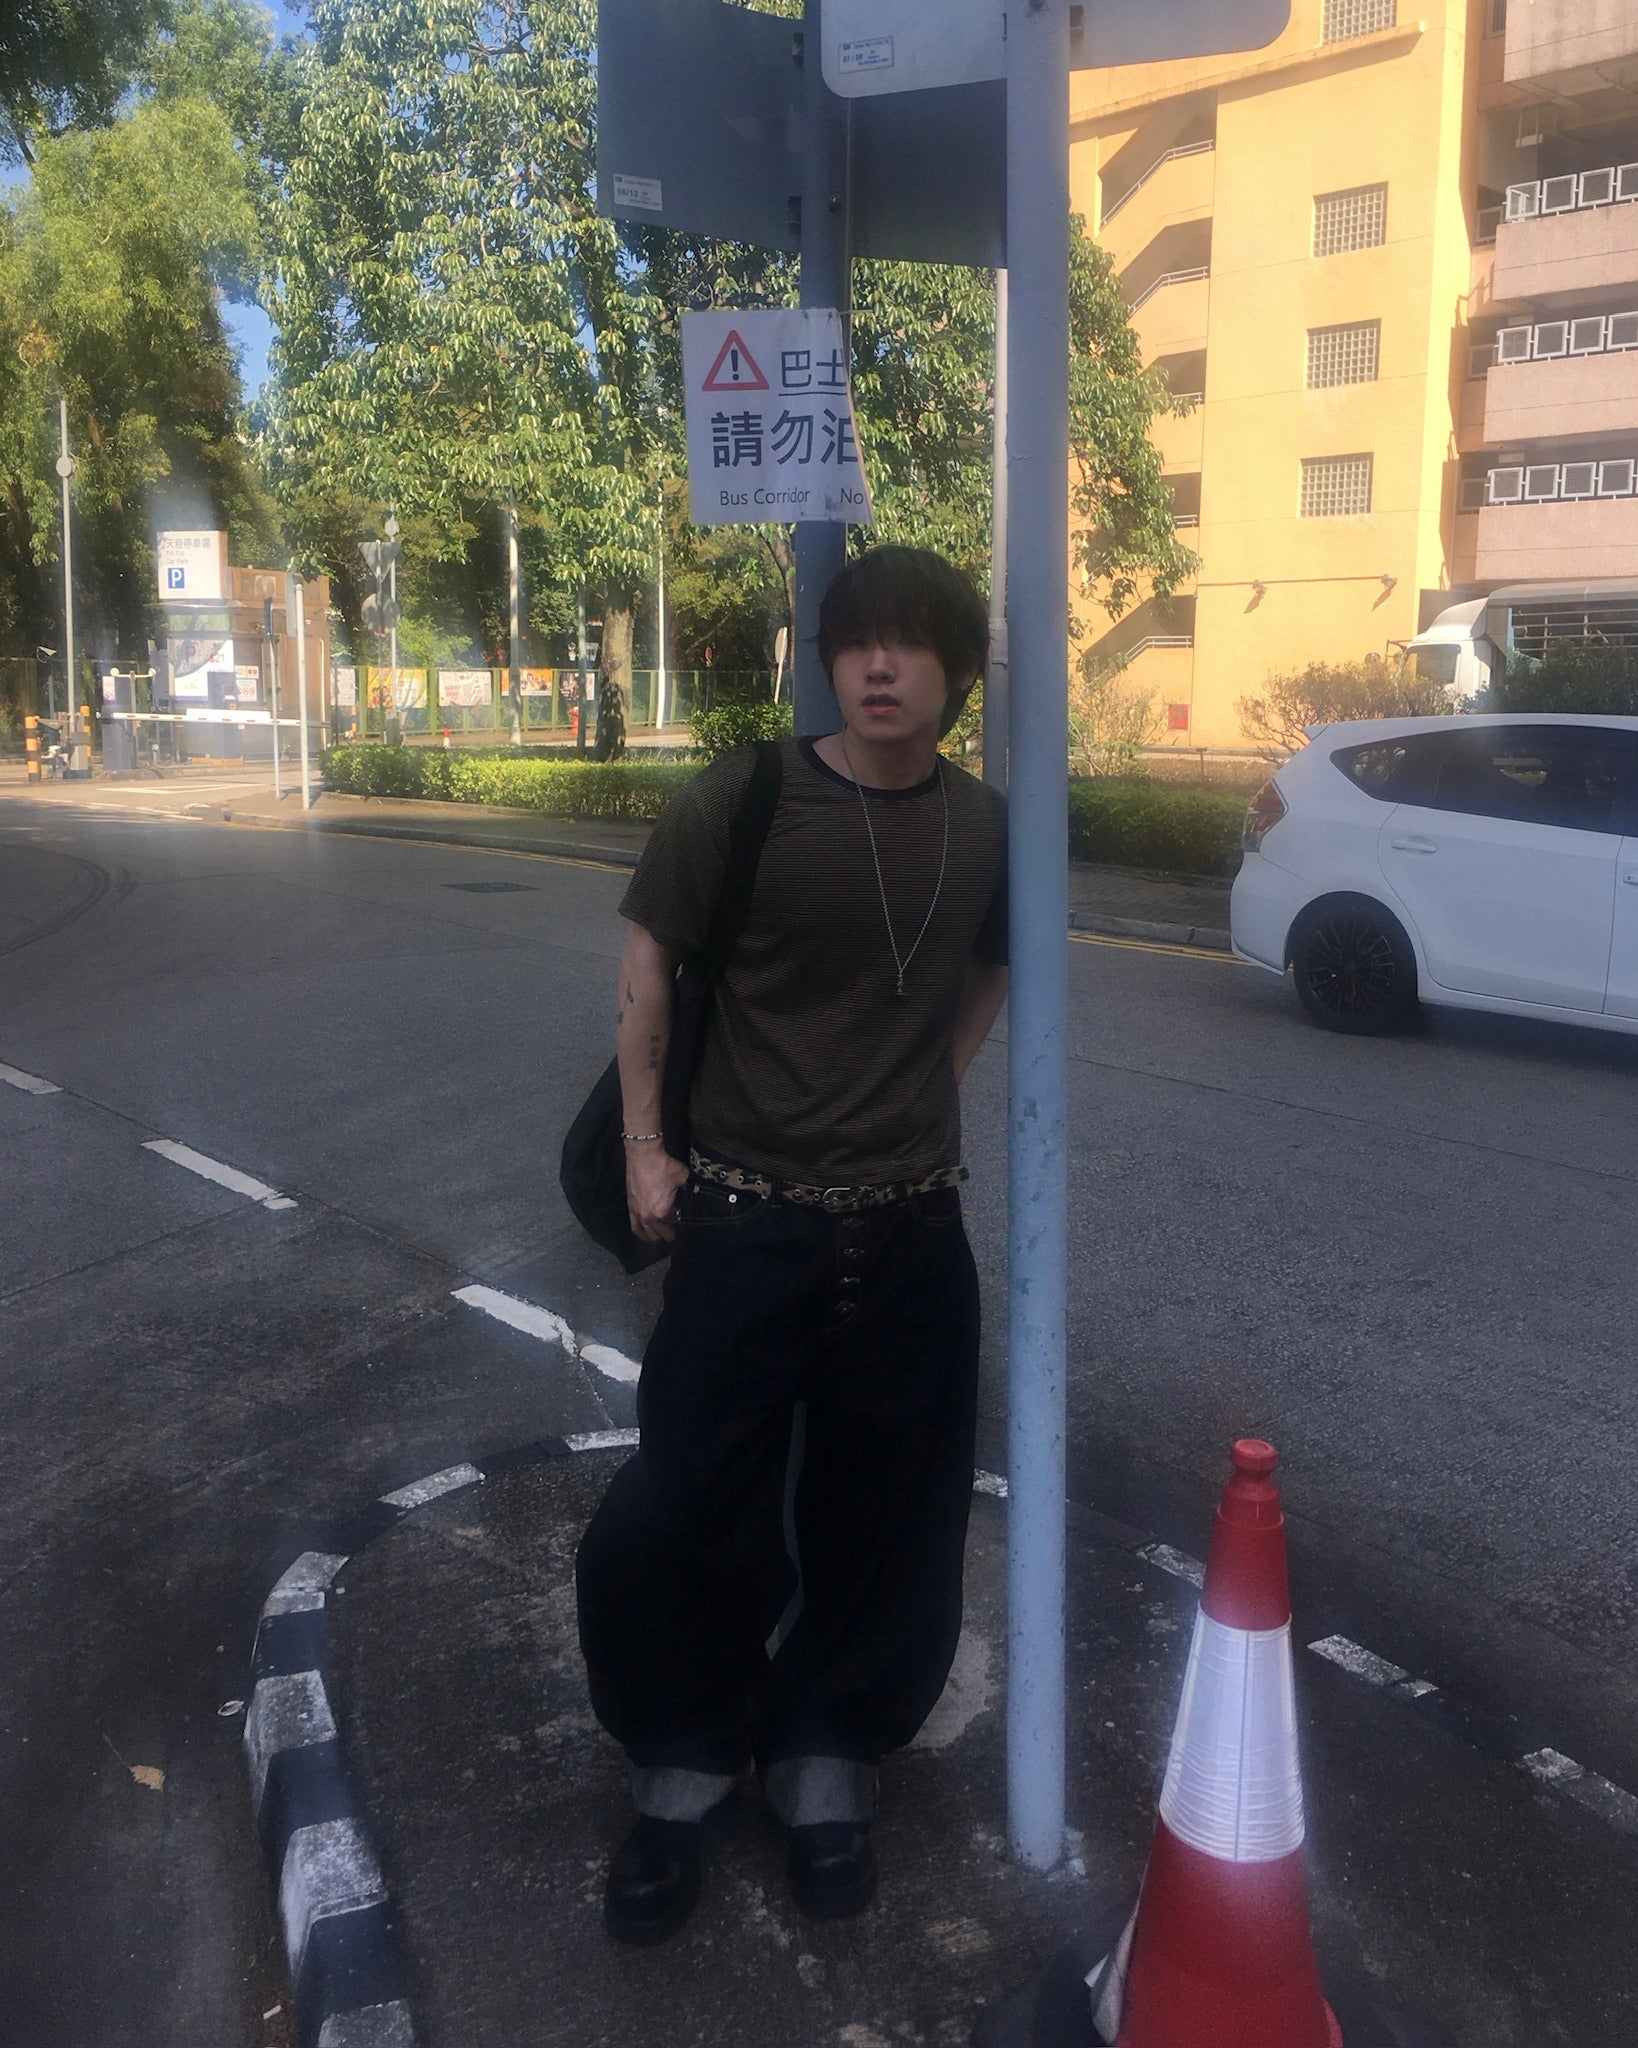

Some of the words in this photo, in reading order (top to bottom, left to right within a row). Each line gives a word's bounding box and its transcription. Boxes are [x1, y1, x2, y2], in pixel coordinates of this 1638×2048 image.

[720, 491, 748, 506] Bus
[753, 488, 811, 505] Corridor
[840, 488, 864, 504] No
[172, 569, 182, 587] P
